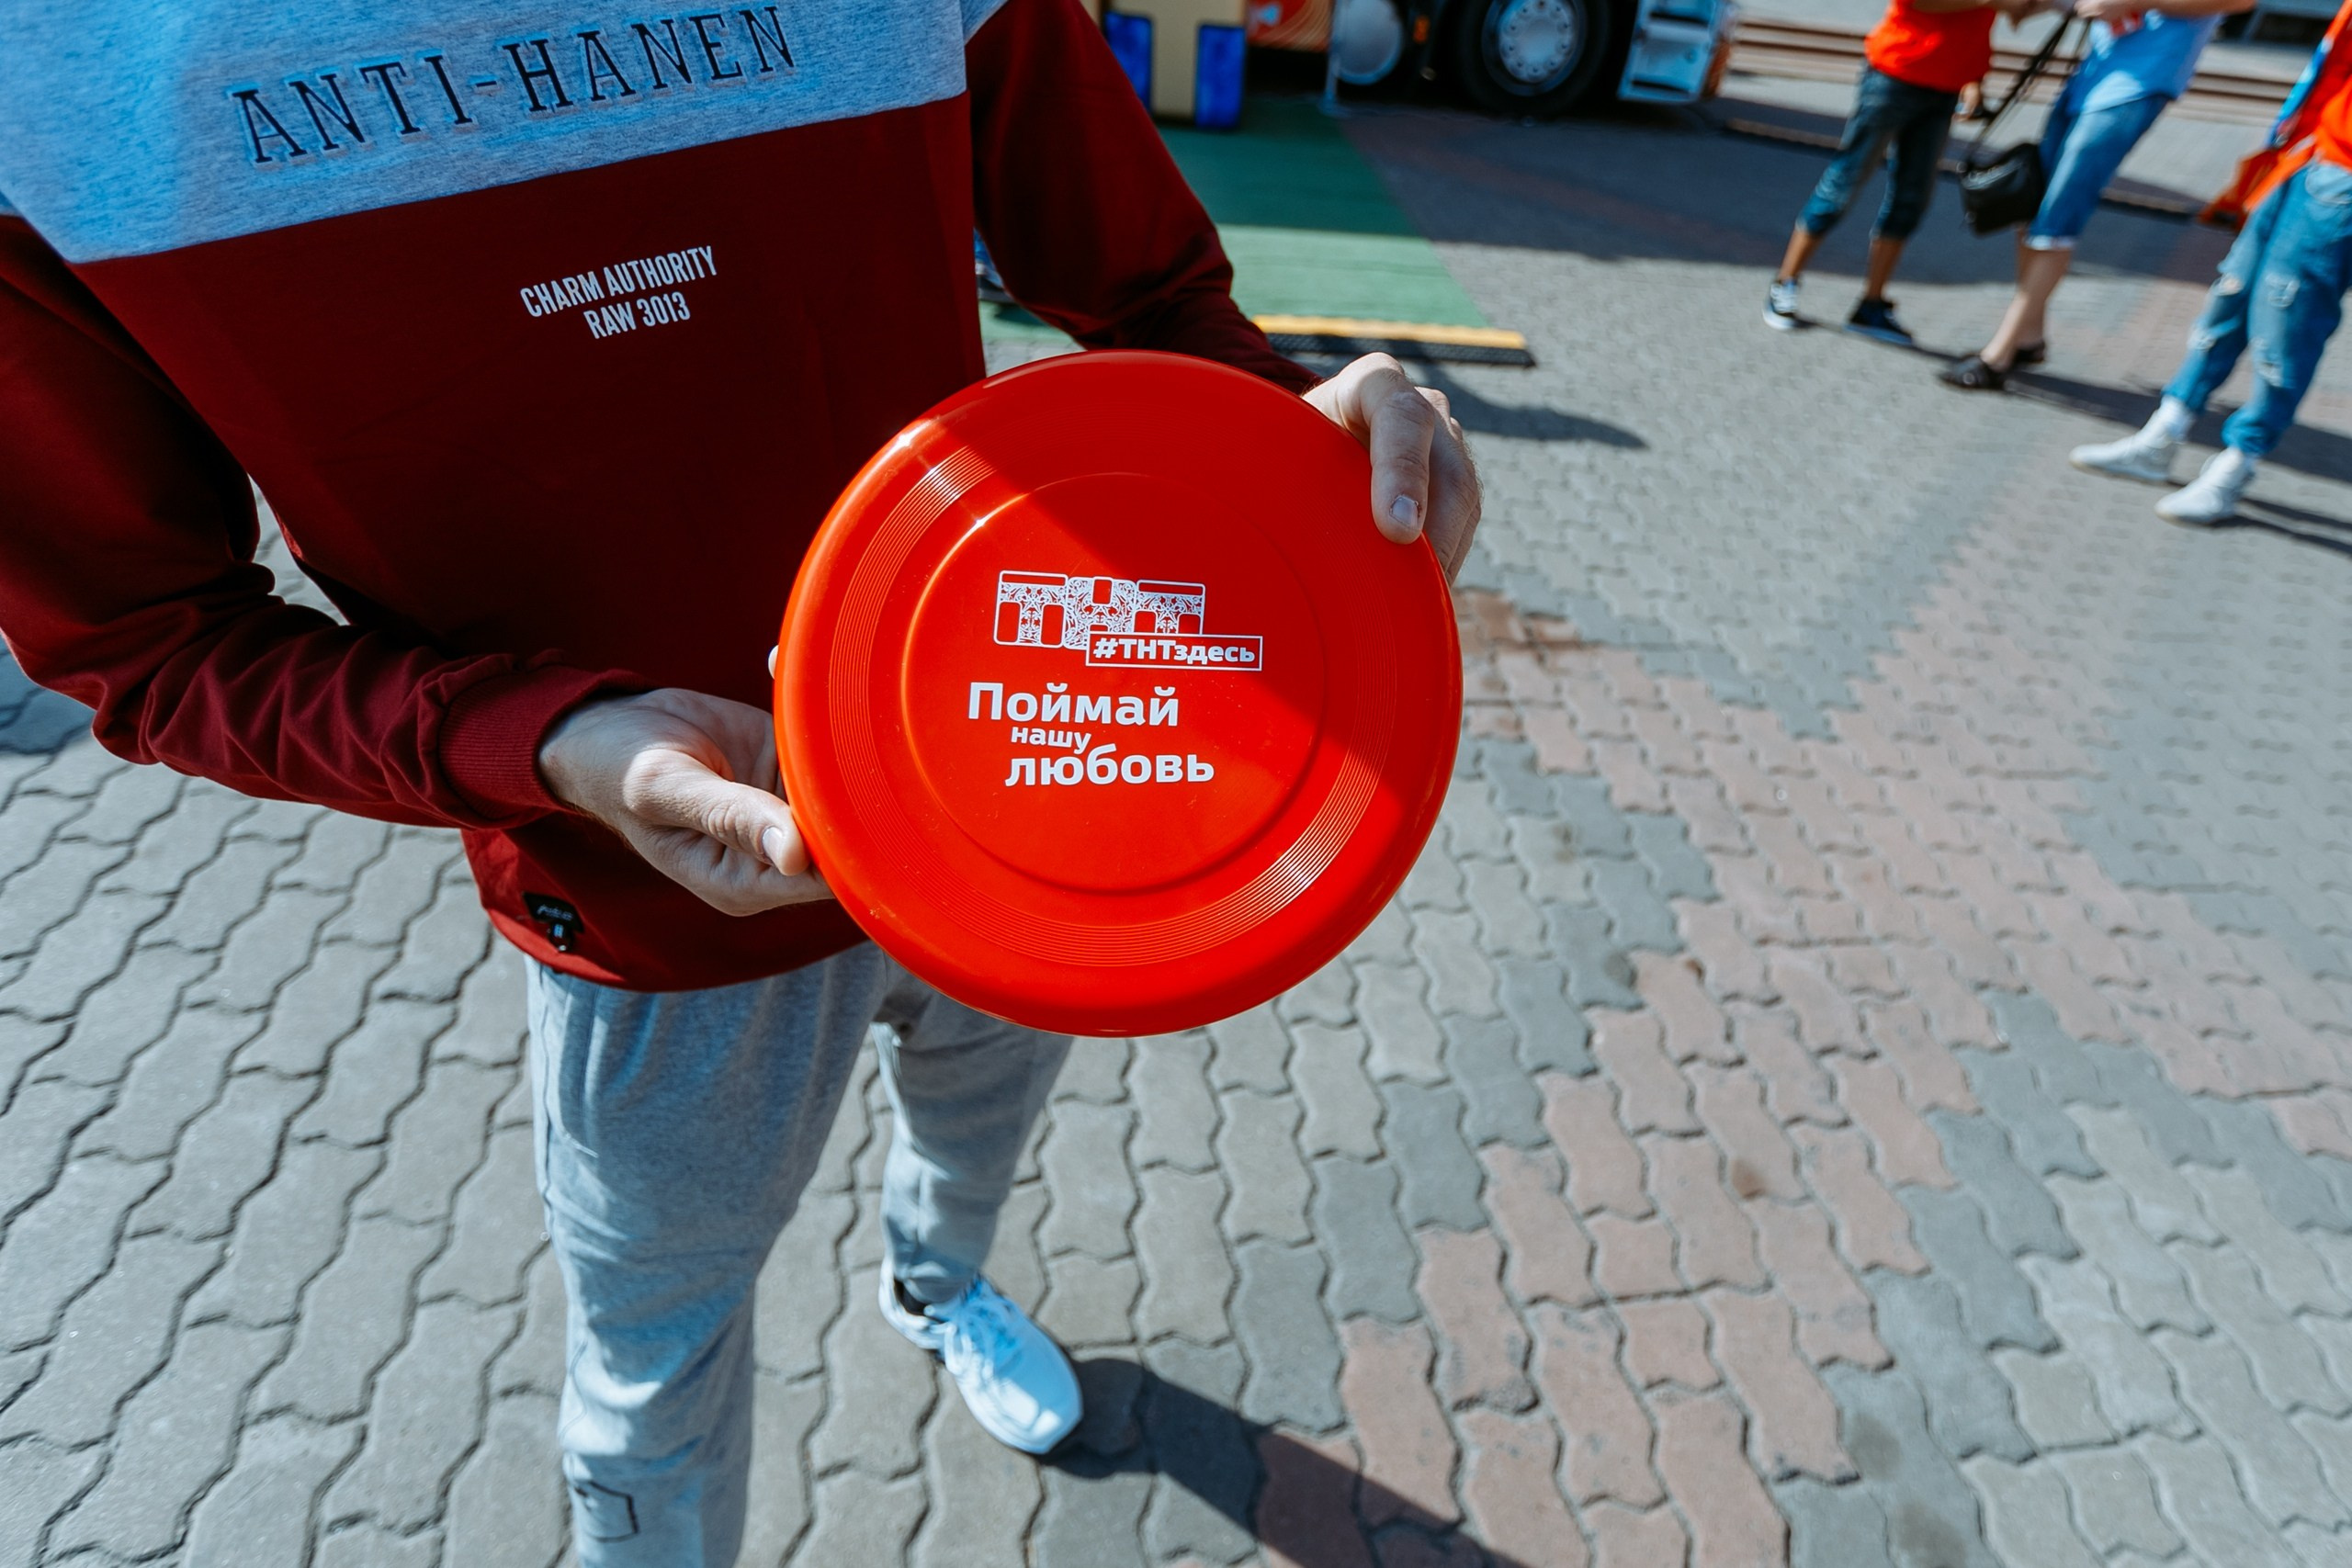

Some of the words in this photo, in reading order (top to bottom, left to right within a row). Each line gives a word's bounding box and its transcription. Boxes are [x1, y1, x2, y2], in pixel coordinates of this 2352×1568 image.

[232, 6, 795, 164] ANTI-HANEN
[520, 271, 605, 318] CHARM
[603, 245, 718, 297] AUTHORITY
[583, 301, 637, 340] RAW
[636, 291, 691, 327] 3013
[1092, 637, 1256, 665] #ТНТздесь
[967, 682, 1179, 727] Поймай
[1010, 727, 1092, 755] нашу
[1004, 743, 1216, 787] любовь
